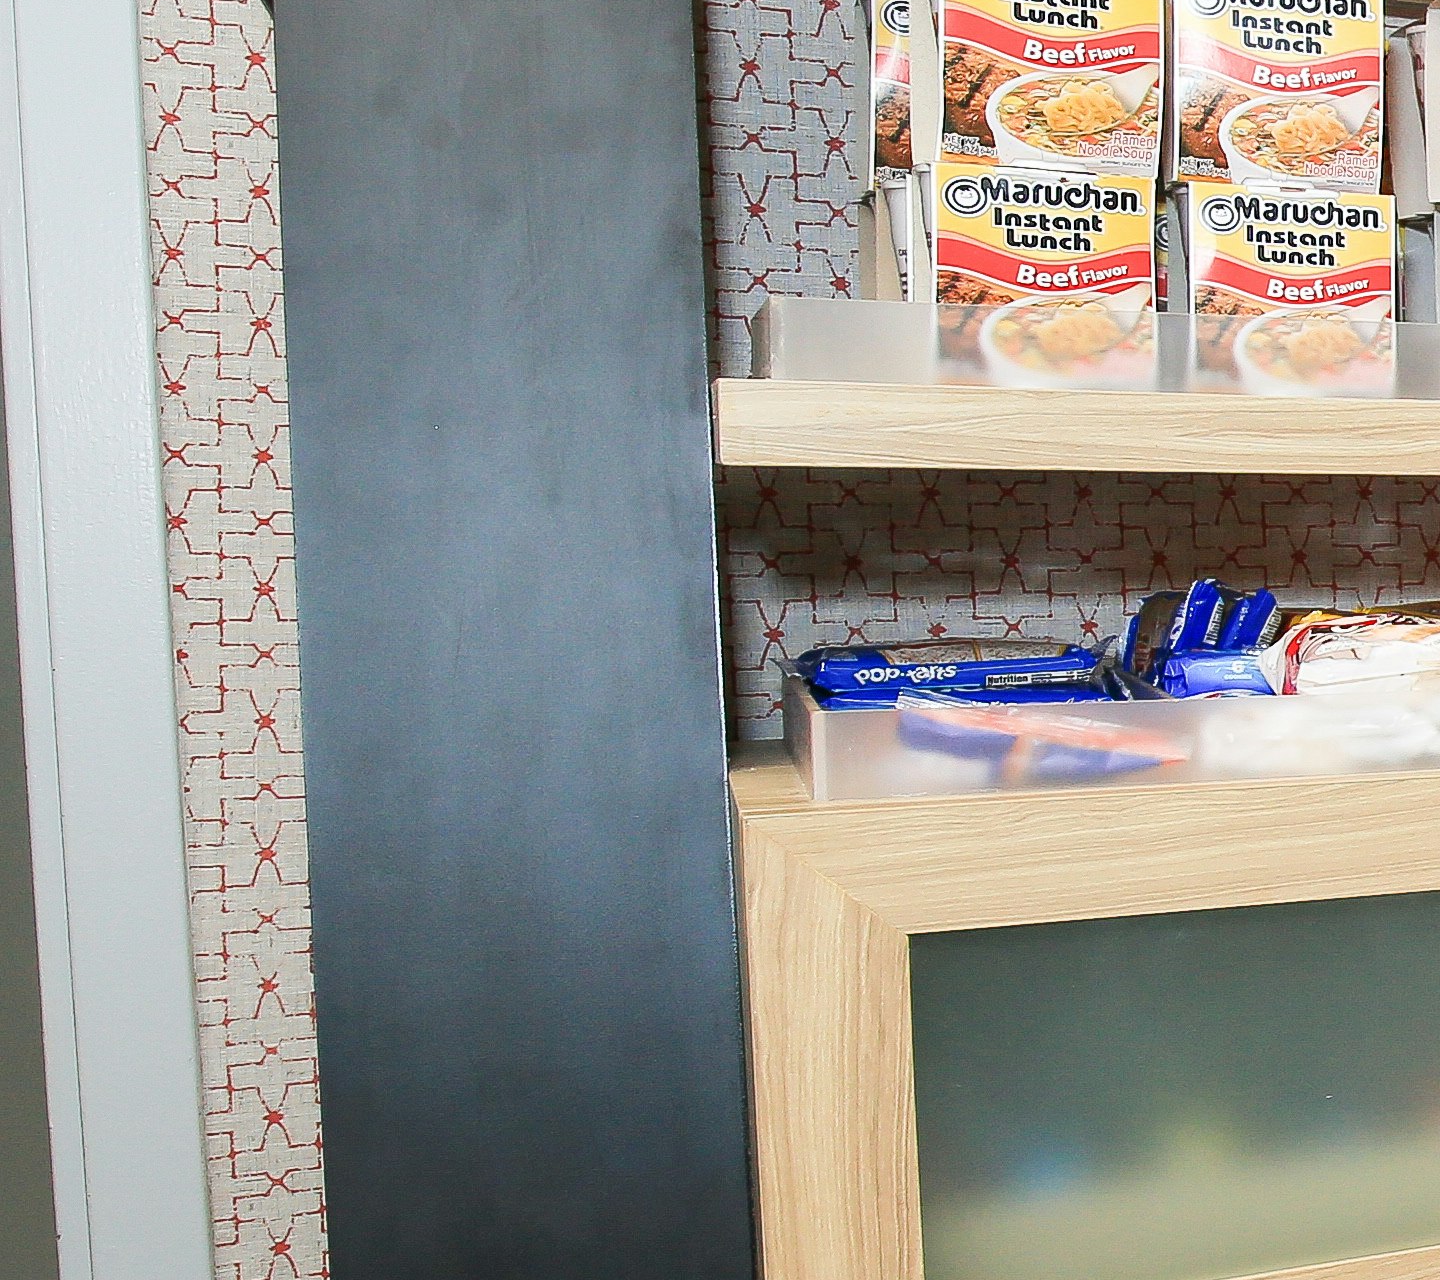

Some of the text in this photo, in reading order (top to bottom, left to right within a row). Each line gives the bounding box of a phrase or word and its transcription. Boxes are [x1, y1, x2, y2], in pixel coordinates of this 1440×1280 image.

[1013, 3, 1098, 30] Lunch
[1233, 10, 1333, 36] Instant
[1023, 39, 1135, 64] Beef Flavor
[1244, 31, 1322, 54] Lunch
[1253, 65, 1357, 87] Beef Flavor
[1113, 131, 1153, 147] Ramen
[1123, 145, 1153, 160] Soup
[1337, 151, 1376, 166] Ramen
[1347, 165, 1375, 179] Soup
[981, 177, 1139, 213] Maruchan
[995, 208, 1103, 232] Instant
[1234, 196, 1379, 228] Maruchan
[1007, 229, 1090, 252] Lunch
[1246, 226, 1345, 248] Instant
[1258, 245, 1335, 266] Lunch
[1016, 264, 1128, 288] Beef Flavor
[1266, 278, 1369, 300] Beef Flavor
[987, 675, 1029, 685] Nutrition
